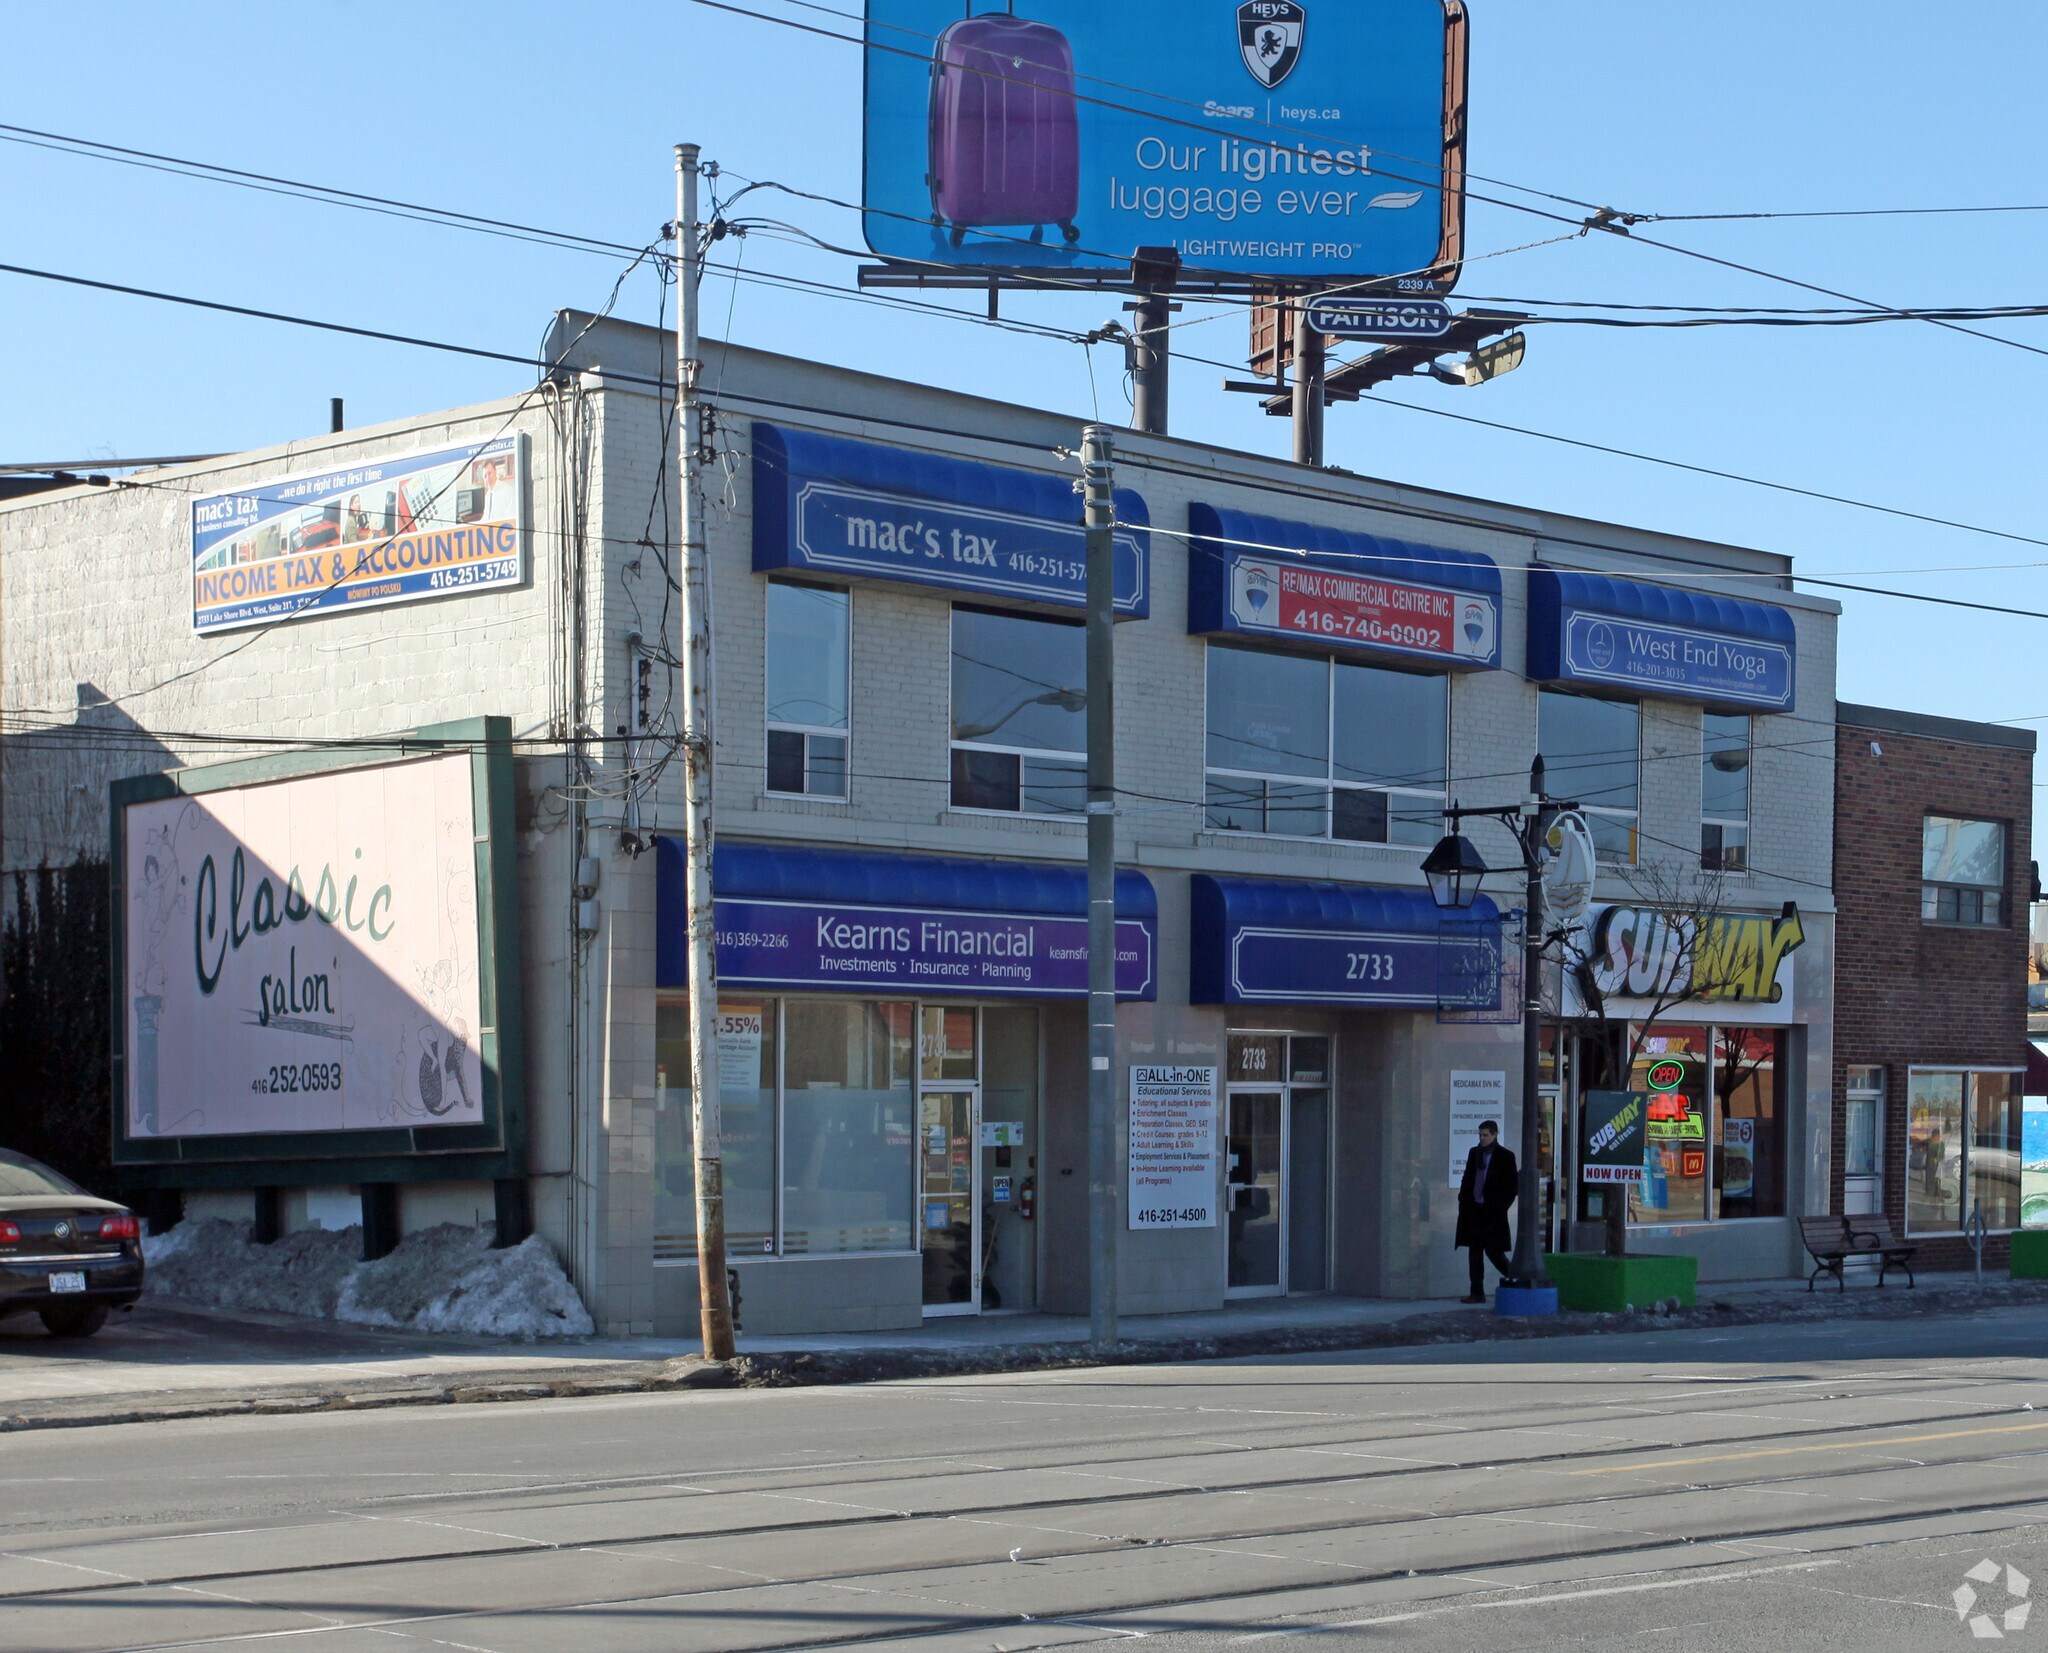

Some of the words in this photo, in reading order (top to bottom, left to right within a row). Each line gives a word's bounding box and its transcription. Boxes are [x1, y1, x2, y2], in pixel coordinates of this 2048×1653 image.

[1203, 100, 1255, 118] Sears
[1281, 105, 1341, 122] heys.ca
[1136, 137, 1207, 171] Our
[1221, 139, 1372, 182] lightest
[1111, 177, 1263, 221] luggage
[1277, 189, 1359, 216] ever
[1171, 239, 1306, 258] LIGHTWEIGHT
[1398, 279, 1424, 290] 2339
[1425, 281, 1435, 291] A
[1319, 305, 1440, 329] PATTISON
[296, 484, 305, 496] do
[306, 481, 312, 493] it
[313, 478, 331, 495] right
[332, 476, 346, 488] the
[347, 471, 363, 486] first
[365, 468, 382, 482] time
[196, 496, 233, 523] mac's
[237, 495, 260, 516] tax
[847, 515, 940, 559] mac's
[951, 526, 998, 568] tax
[197, 563, 278, 604] INCOME
[283, 555, 323, 585] TAX
[331, 552, 346, 581] &
[355, 523, 516, 577] ACCOUNTING
[430, 560, 517, 589] 416-251-5749
[1009, 552, 1087, 580] 416-251-57
[1282, 570, 1322, 597] RE/MAX
[1323, 577, 1390, 607] COMMERCIAL
[1392, 588, 1431, 614] CENTRE
[1433, 595, 1451, 618] INC.
[1293, 609, 1440, 648] 416-740-0002
[1627, 630, 1677, 661] West
[1684, 639, 1718, 667] End
[1723, 646, 1766, 680] Yoga
[1626, 661, 1685, 681] 416-201-3035
[196, 845, 395, 996] Classic
[714, 931, 789, 948] 416)369-2266
[817, 915, 911, 951] Kearns
[921, 921, 1034, 957] Financial
[1594, 901, 1806, 1000] SUBWAY
[819, 955, 897, 972] Investments
[909, 959, 970, 976] Insurance
[982, 962, 1032, 981] Planning
[1346, 953, 1394, 981] 2733
[258, 945, 335, 1026] salon
[719, 1016, 760, 1034] .55%
[1646, 1037, 1691, 1054] SUBWAY
[1242, 1046, 1266, 1071] 2733
[251, 1079, 267, 1095] 416
[1653, 1067, 1679, 1082] OPEN
[1137, 1086, 1180, 1096] Educational
[1181, 1086, 1211, 1096] Services
[1589, 1096, 1642, 1155] SUBWAY
[1151, 1141, 1174, 1150] Learning
[1608, 1138, 1620, 1151] eat
[1159, 1165, 1181, 1173] Learning
[1182, 1164, 1205, 1172] available
[1586, 1167, 1611, 1179] NOW
[1614, 1168, 1641, 1180] OPEN
[994, 1178, 1009, 1188] OPEN
[1138, 1208, 1206, 1222] 416-251-4500
